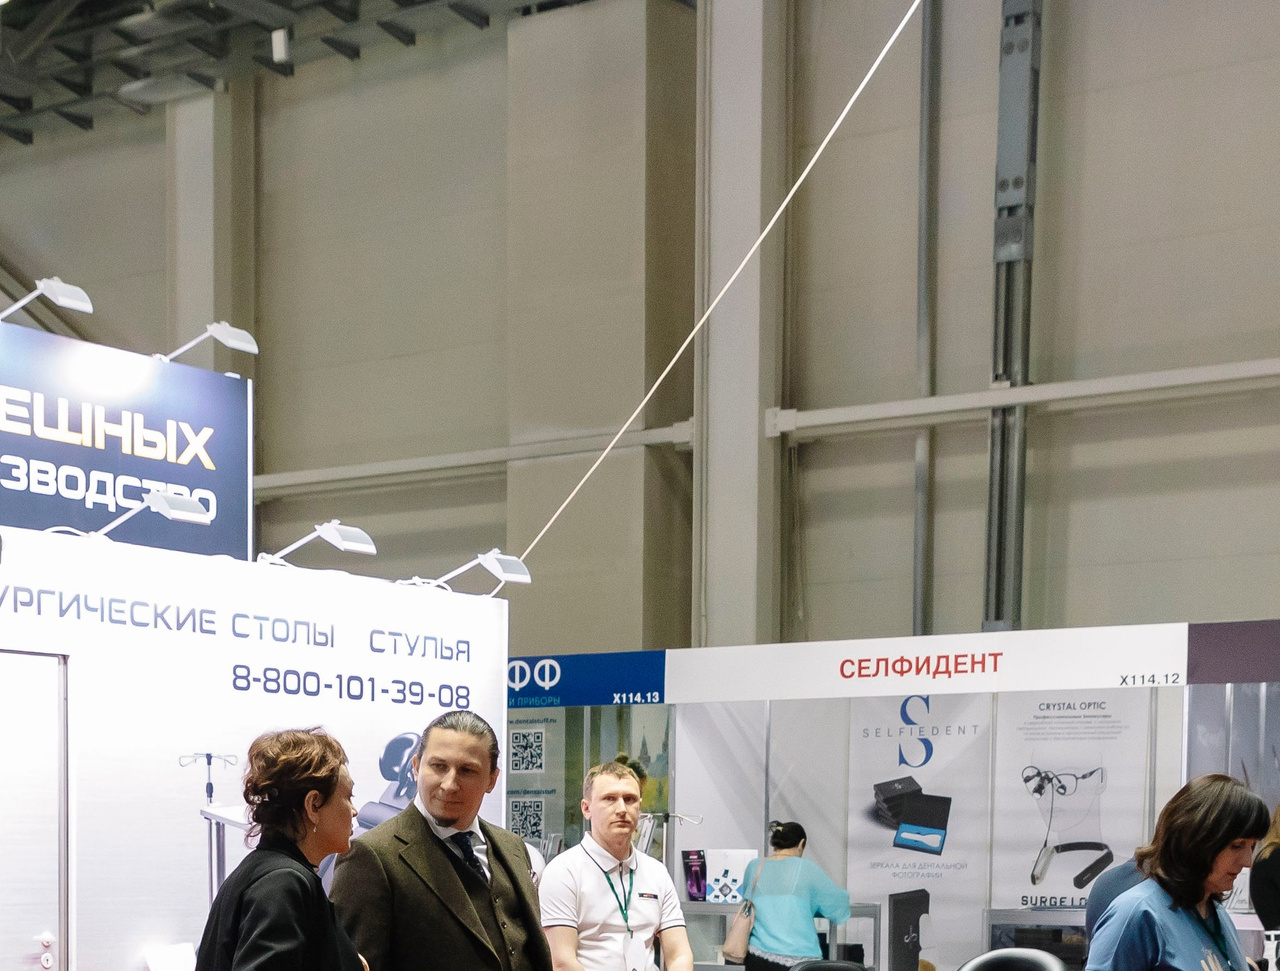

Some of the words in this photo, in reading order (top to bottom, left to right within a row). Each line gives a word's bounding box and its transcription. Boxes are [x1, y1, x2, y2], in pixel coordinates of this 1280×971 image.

[231, 612, 335, 649] СТОЛЫ
[369, 628, 471, 663] СТУЛЬЯ
[839, 652, 1004, 680] СЕЛФИДЕНТ
[1119, 672, 1180, 686] X114.12
[232, 664, 471, 710] 8-800-101-39-08
[612, 691, 660, 704] X114.13
[1038, 702, 1077, 712] CRYSTAL
[1079, 701, 1107, 711] OPTIC
[862, 724, 980, 738] SELFIEDENT
[902, 862, 917, 870] ДЛЯ
